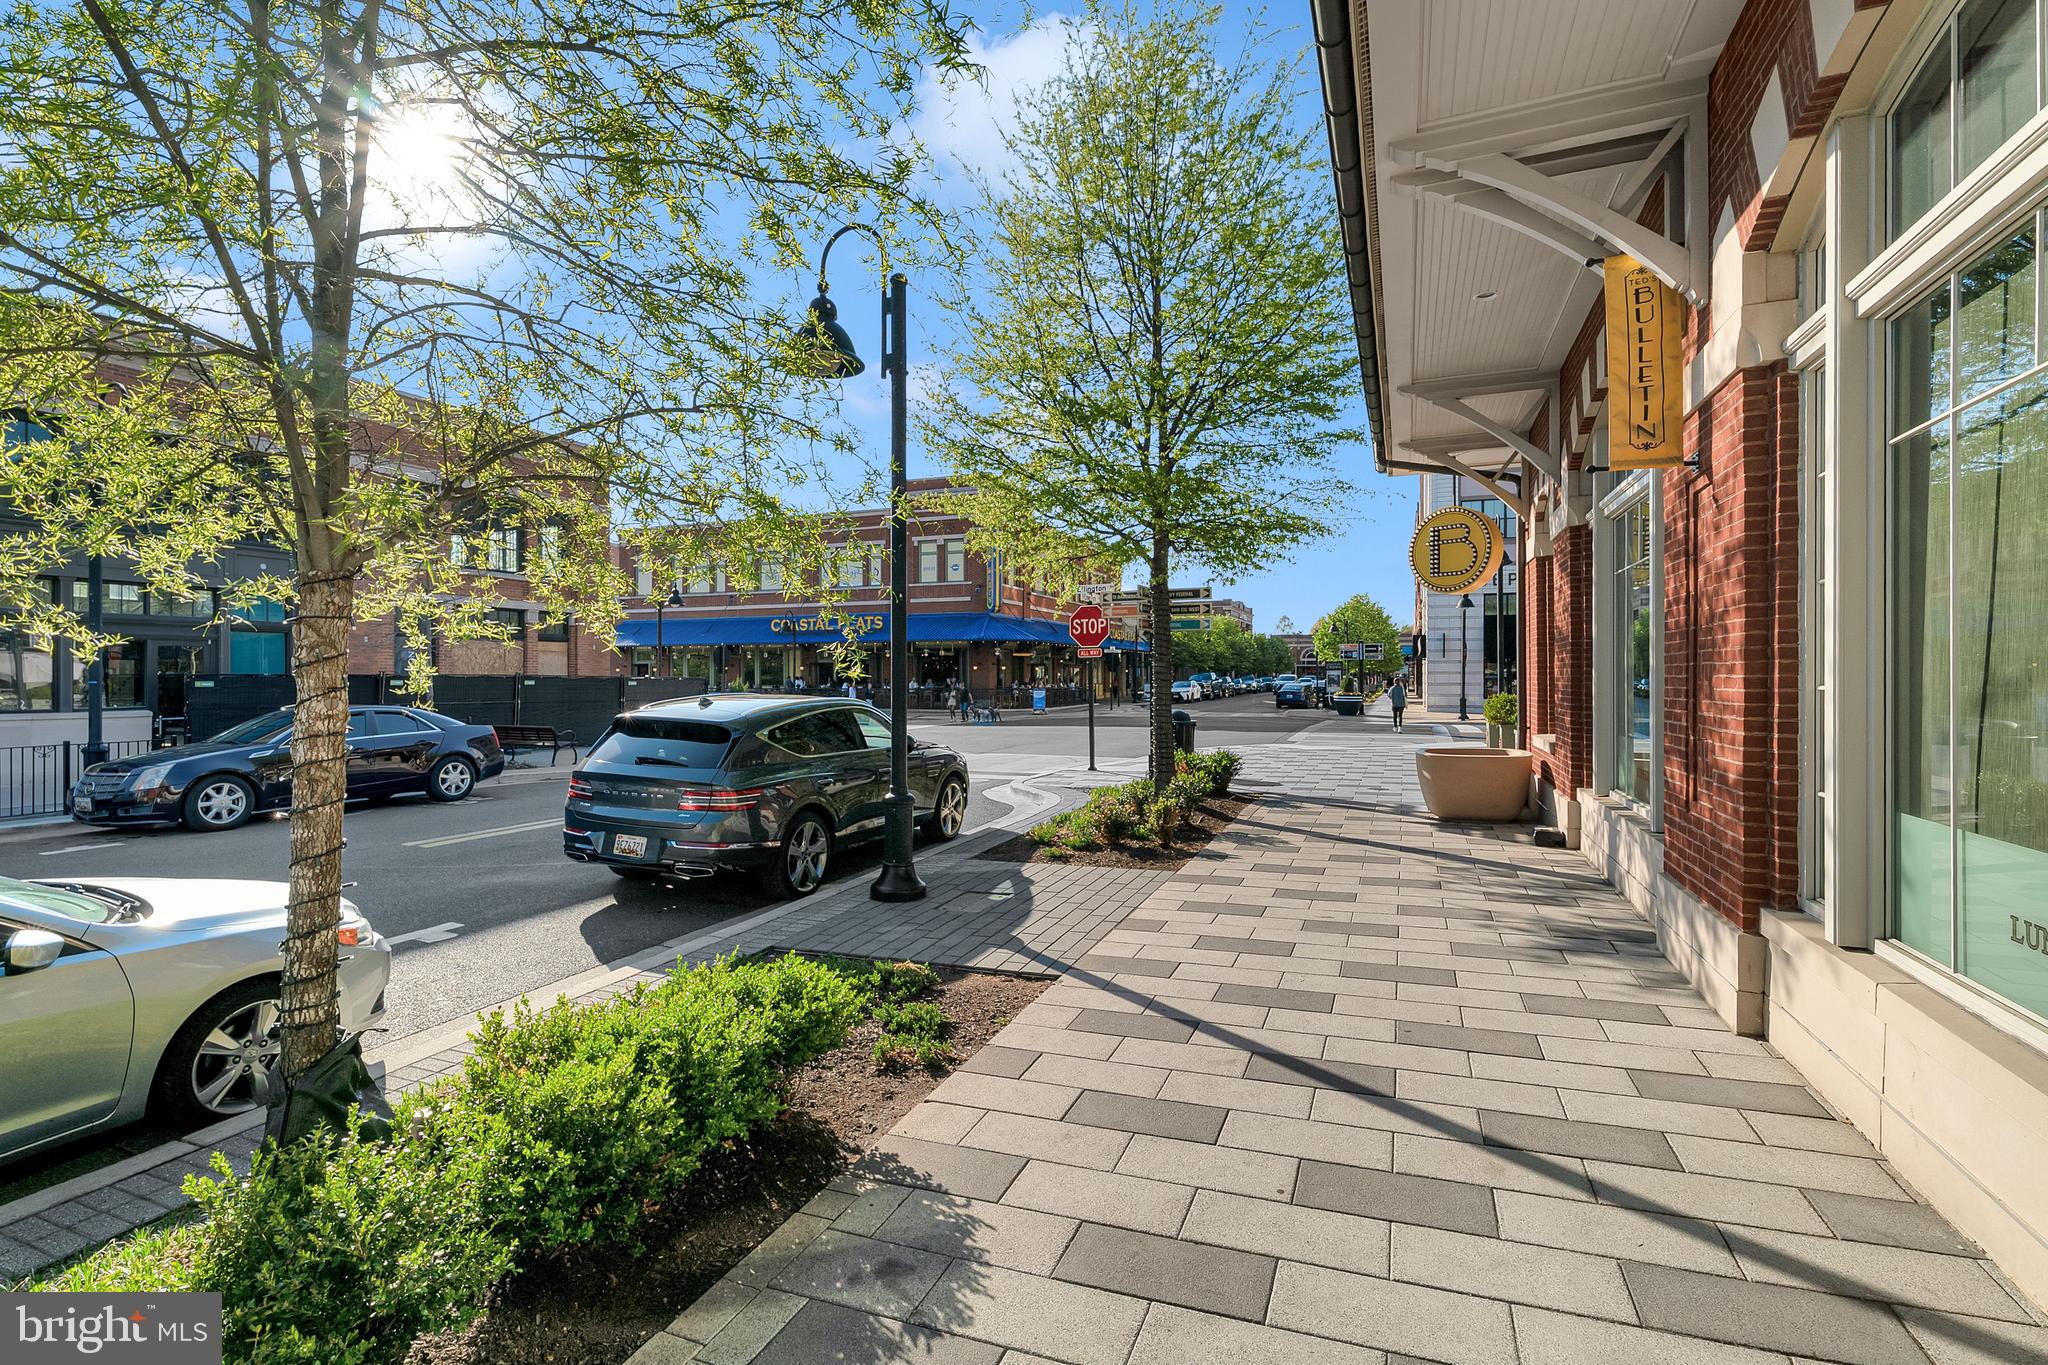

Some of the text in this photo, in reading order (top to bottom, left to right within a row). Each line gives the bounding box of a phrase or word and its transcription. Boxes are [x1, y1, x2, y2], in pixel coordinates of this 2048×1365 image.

[1629, 275, 1657, 286] TED'S
[1633, 286, 1656, 439] BULLETIN
[1425, 523, 1478, 578] B
[1072, 618, 1107, 635] STOP
[603, 789, 664, 798] GENESIS
